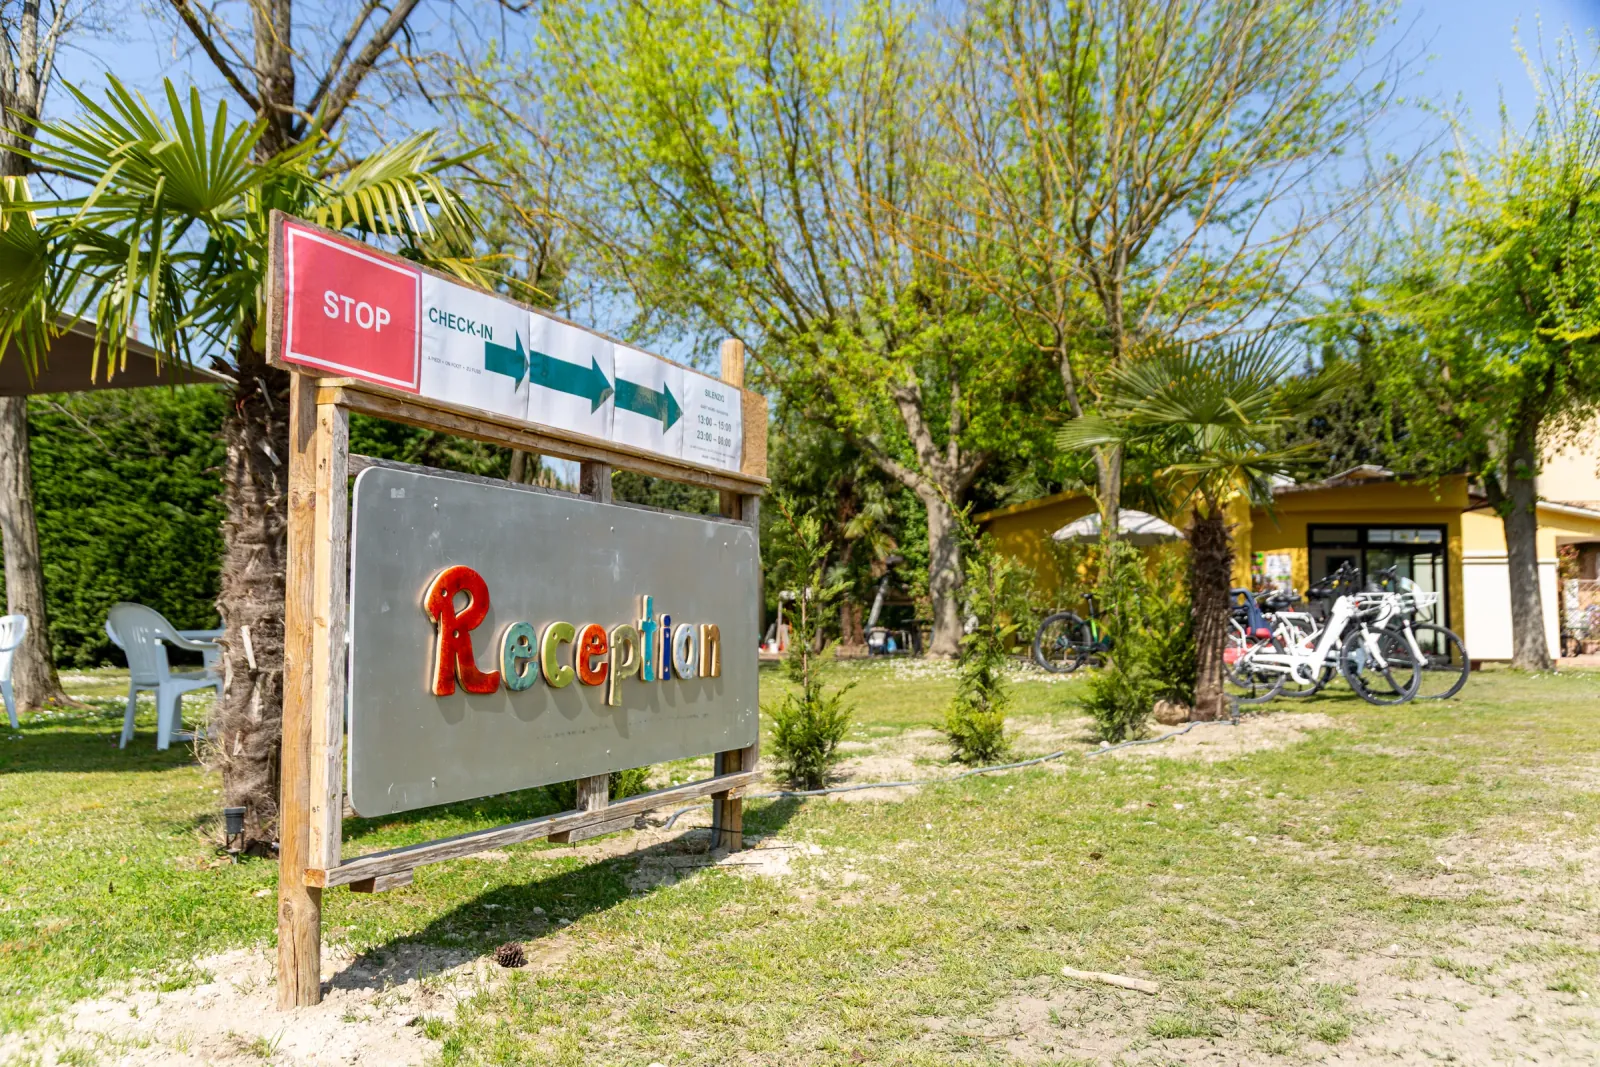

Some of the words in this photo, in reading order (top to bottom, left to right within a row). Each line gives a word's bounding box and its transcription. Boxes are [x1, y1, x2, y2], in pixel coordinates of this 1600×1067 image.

[323, 290, 391, 333] STOP
[428, 307, 493, 341] CHECK-IN
[696, 430, 712, 441] 23:00
[697, 415, 712, 426] 13:00
[718, 421, 731, 432] 15:00
[424, 565, 722, 706] Reception
